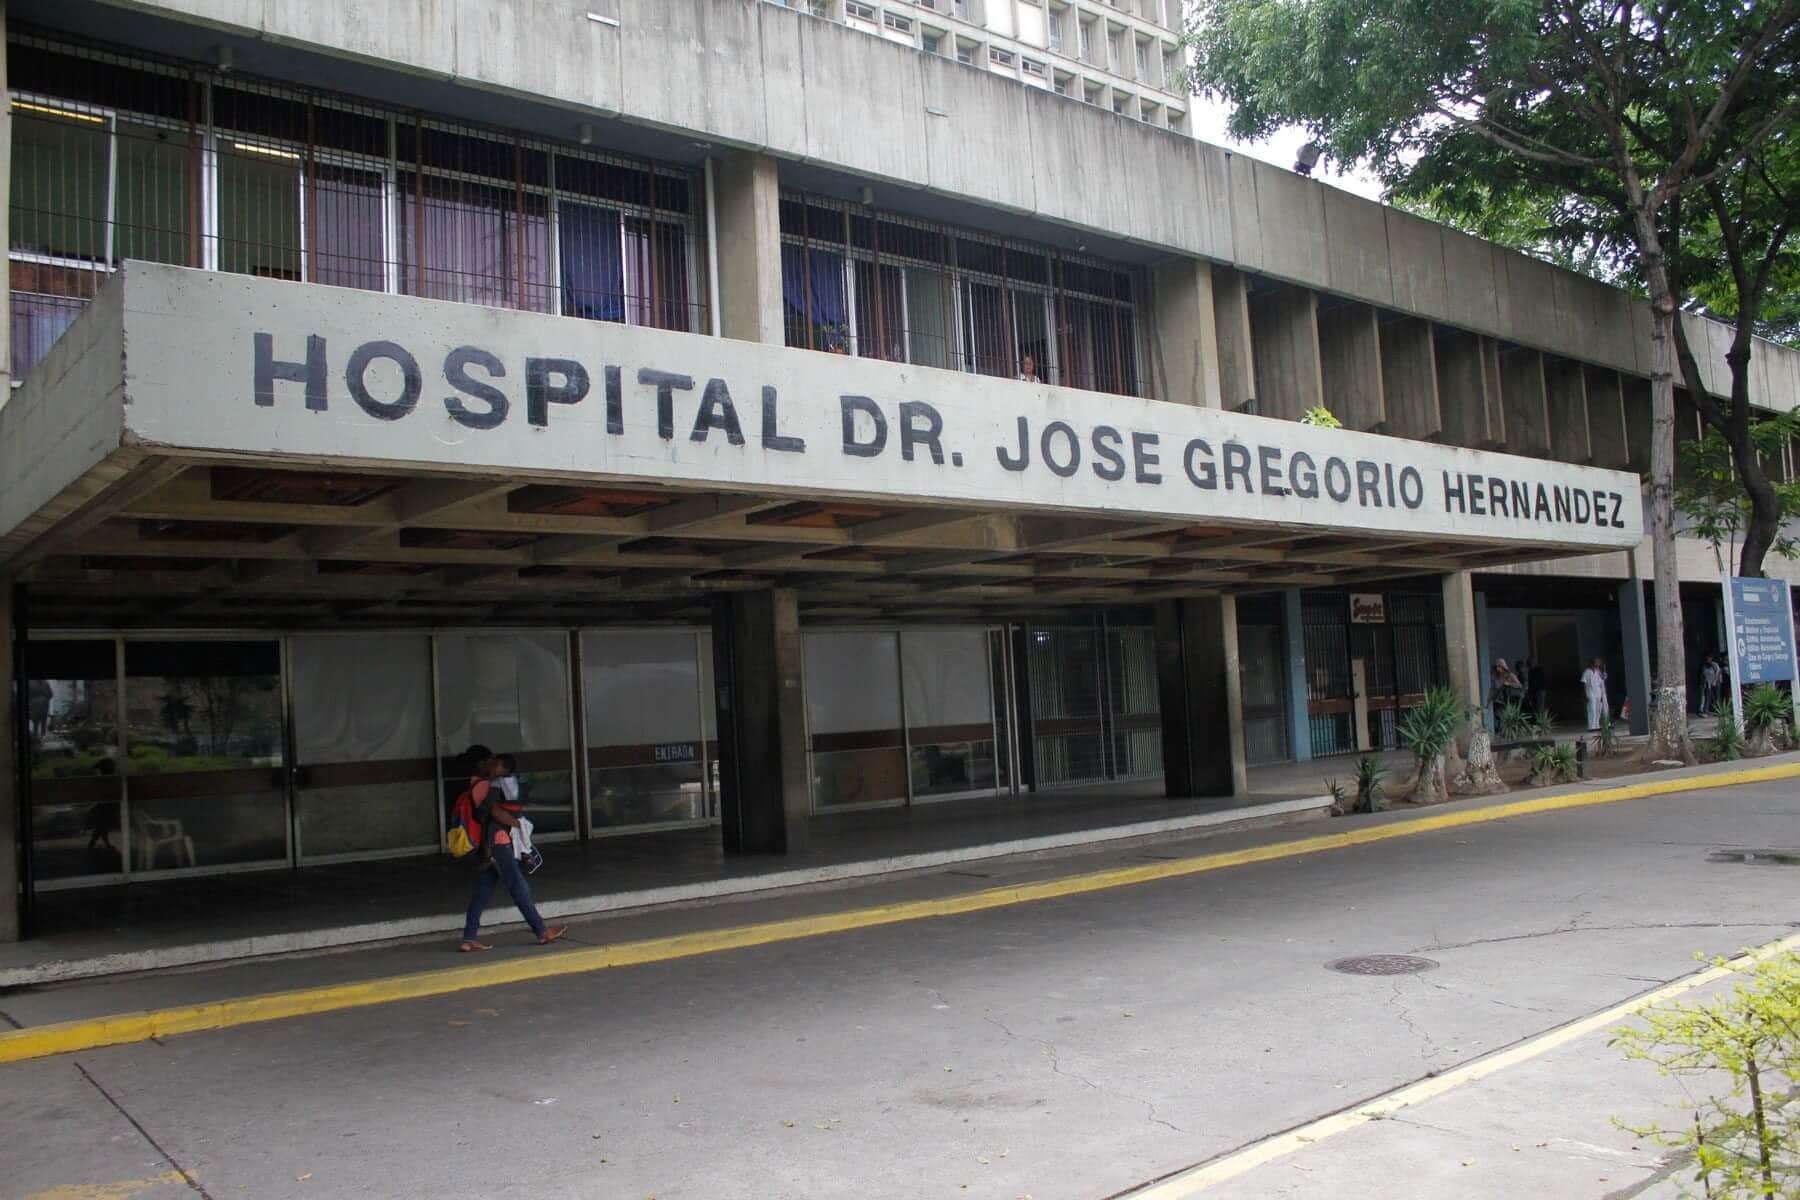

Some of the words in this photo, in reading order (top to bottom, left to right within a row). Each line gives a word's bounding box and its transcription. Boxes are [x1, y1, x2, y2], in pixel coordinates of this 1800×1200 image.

[253, 332, 806, 454] HOSPITAL
[841, 395, 964, 467] DR.
[996, 416, 1162, 485] JOSE
[1183, 438, 1425, 511] GREGORIO
[1442, 470, 1626, 529] HERNANDEZ
